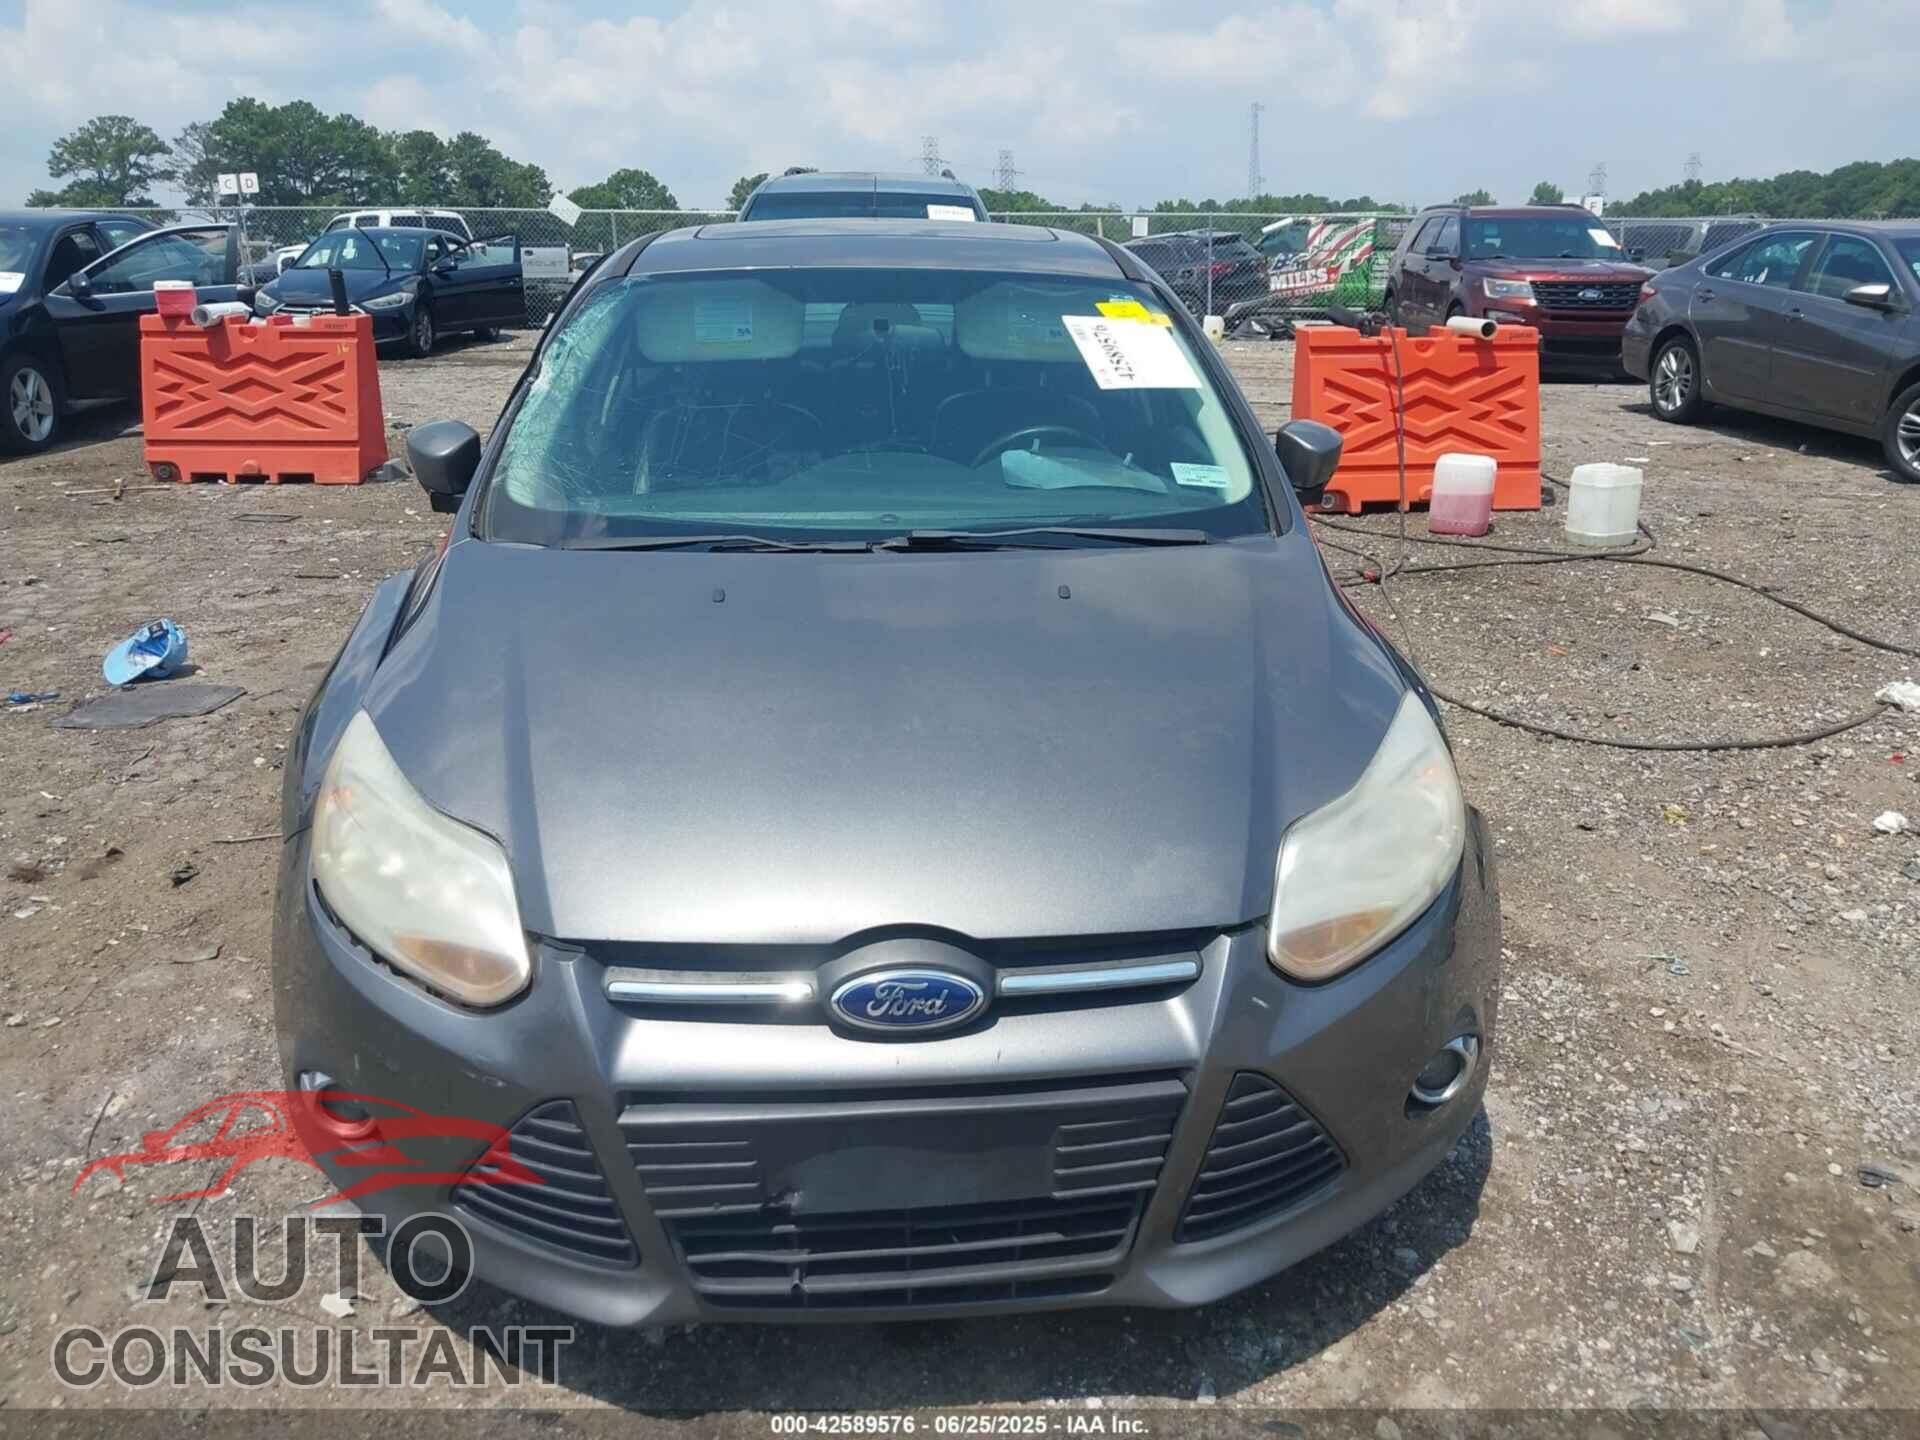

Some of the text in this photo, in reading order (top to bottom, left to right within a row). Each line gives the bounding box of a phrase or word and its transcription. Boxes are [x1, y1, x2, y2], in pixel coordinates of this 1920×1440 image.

[224, 178, 232, 190] C
[245, 178, 254, 189] D
[1270, 267, 1329, 291] MILES
[866, 981, 949, 1017] Ford
